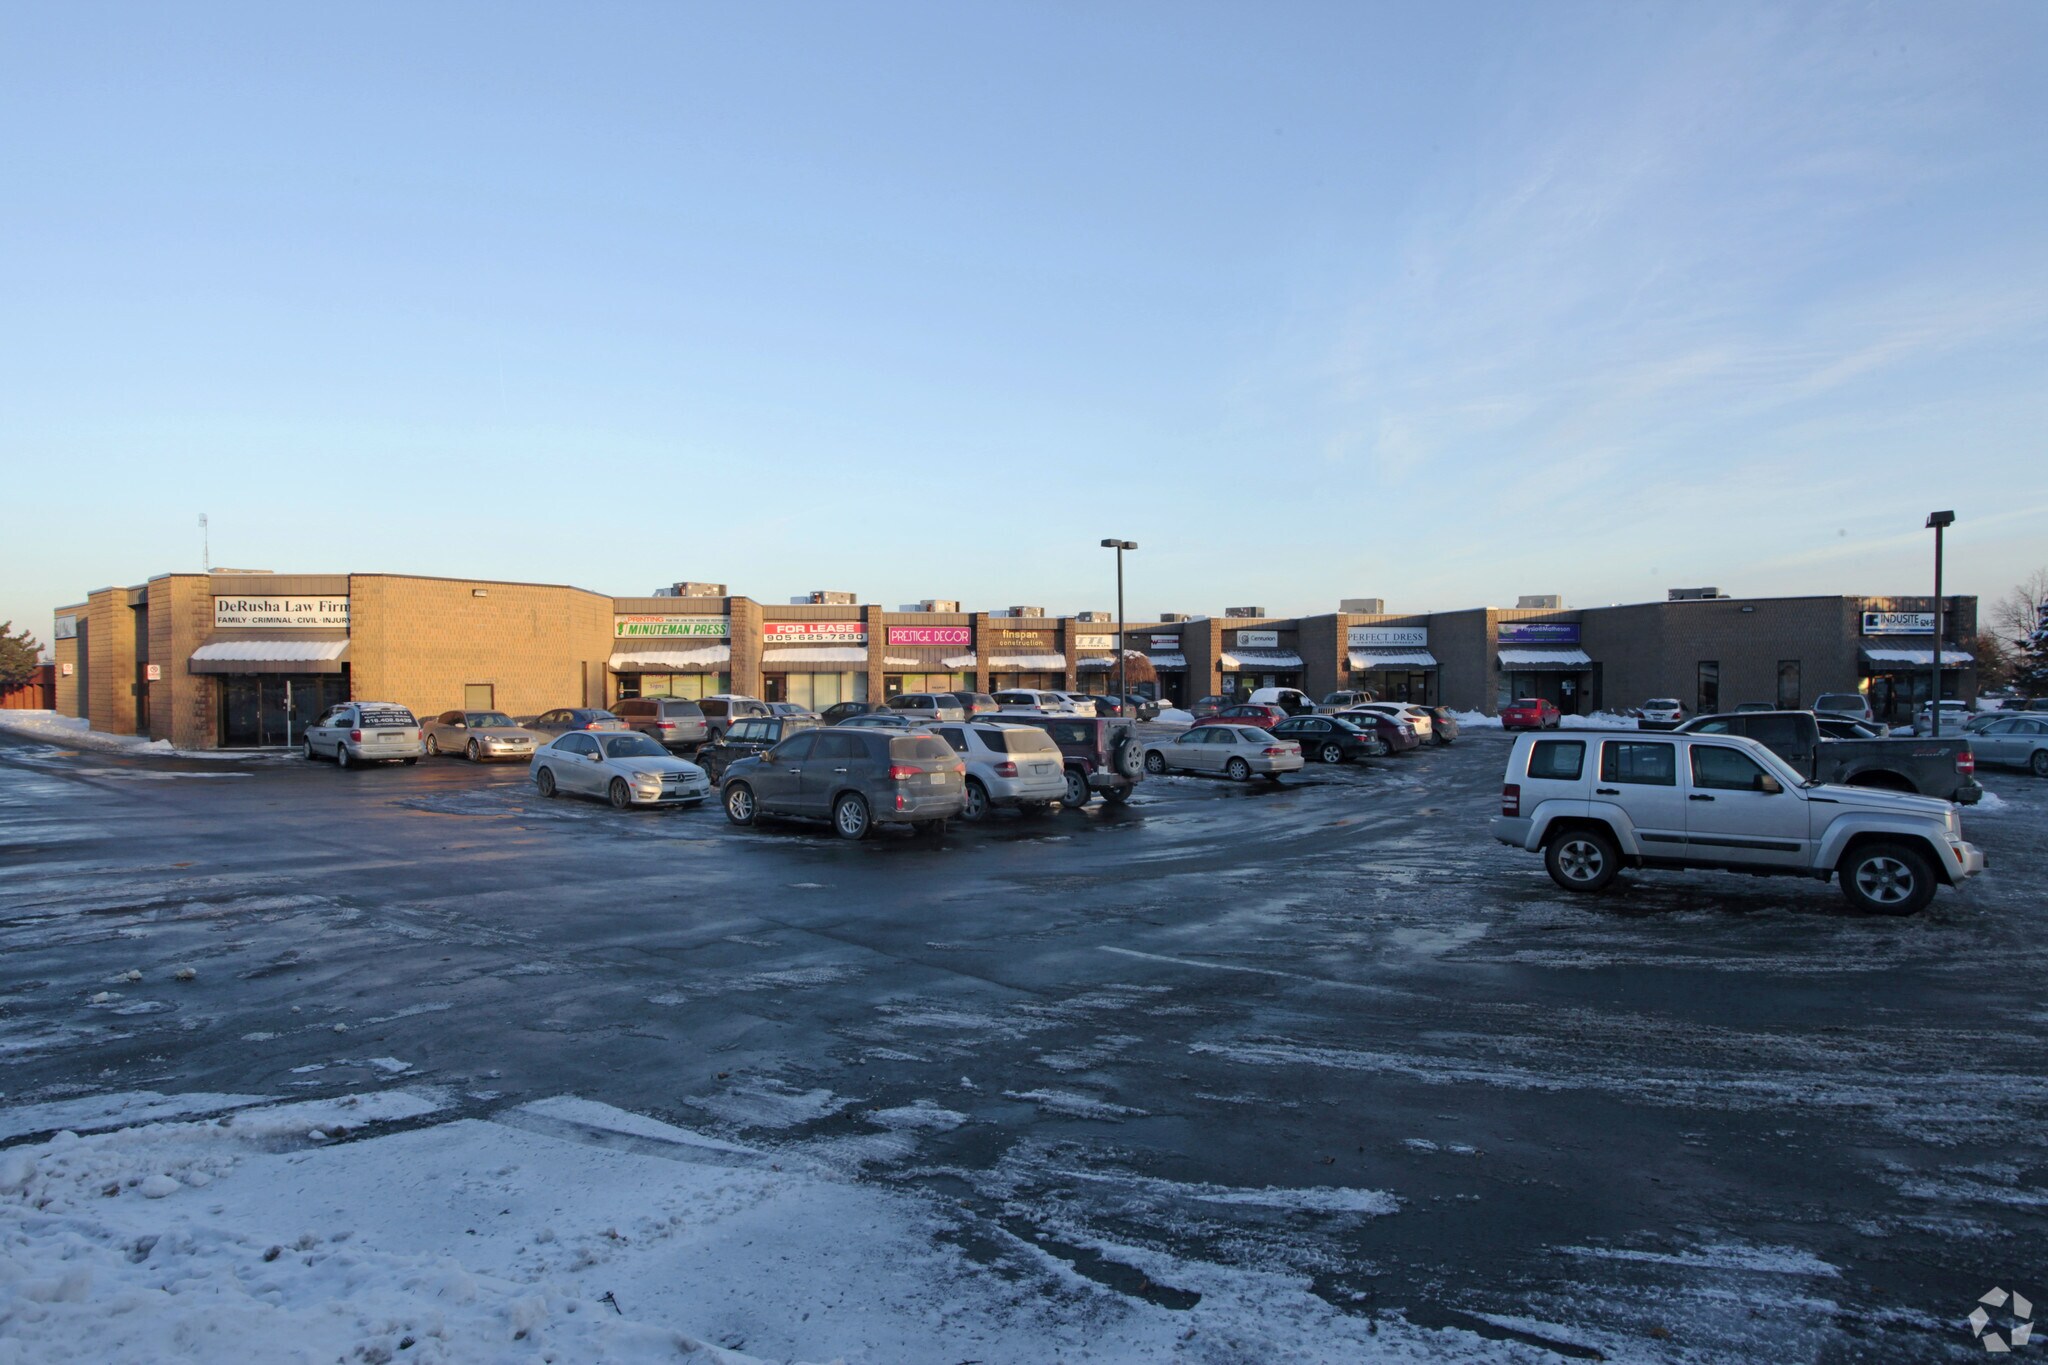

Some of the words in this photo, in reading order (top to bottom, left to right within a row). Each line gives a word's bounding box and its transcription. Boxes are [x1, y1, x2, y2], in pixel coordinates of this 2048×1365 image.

[218, 600, 280, 612] DeRusha
[285, 601, 315, 612] Law
[319, 600, 350, 612] Firm
[1880, 614, 1919, 624] INDUSITE
[628, 624, 691, 635] MINUTEMAN
[693, 624, 727, 635] PRESS
[776, 624, 805, 633] FOR
[809, 624, 855, 633] LEASE
[891, 630, 932, 642] PRESTIGE
[934, 630, 969, 642] DECOR
[1002, 629, 1038, 641] finspan
[1347, 633, 1389, 641] PERFECT
[1393, 633, 1423, 641] DRESS
